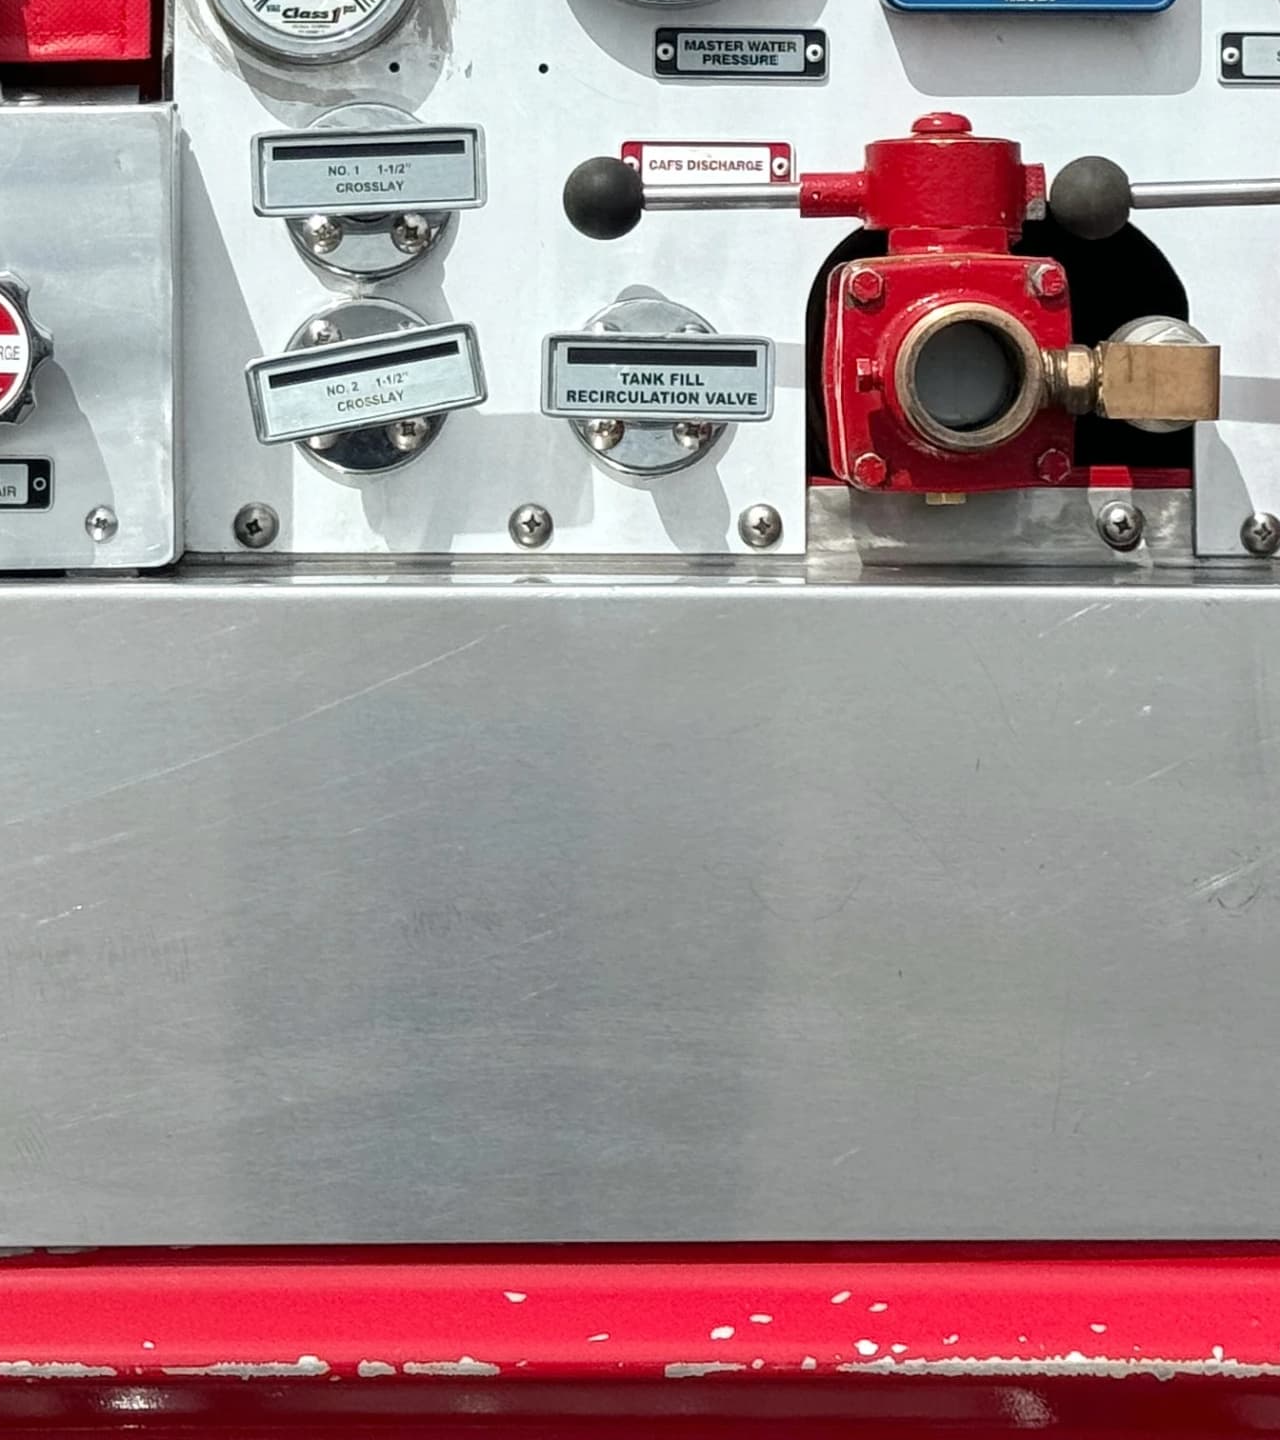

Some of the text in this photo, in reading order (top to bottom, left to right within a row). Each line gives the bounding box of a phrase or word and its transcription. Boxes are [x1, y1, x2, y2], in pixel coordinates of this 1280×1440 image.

[684, 40, 797, 53] MASTER WATER
[702, 54, 779, 66] PRESSURE
[328, 165, 350, 176] NO.
[354, 165, 360, 176] 1
[649, 159, 764, 172] CAFS DISCHARGE
[336, 180, 405, 193] CROSSLAY
[620, 372, 705, 387] TANK FILL
[326, 382, 350, 397] NO.
[352, 381, 360, 392] 2
[337, 390, 406, 412] CROSSLAY
[566, 390, 758, 406] RECIRCULATION VALVE
